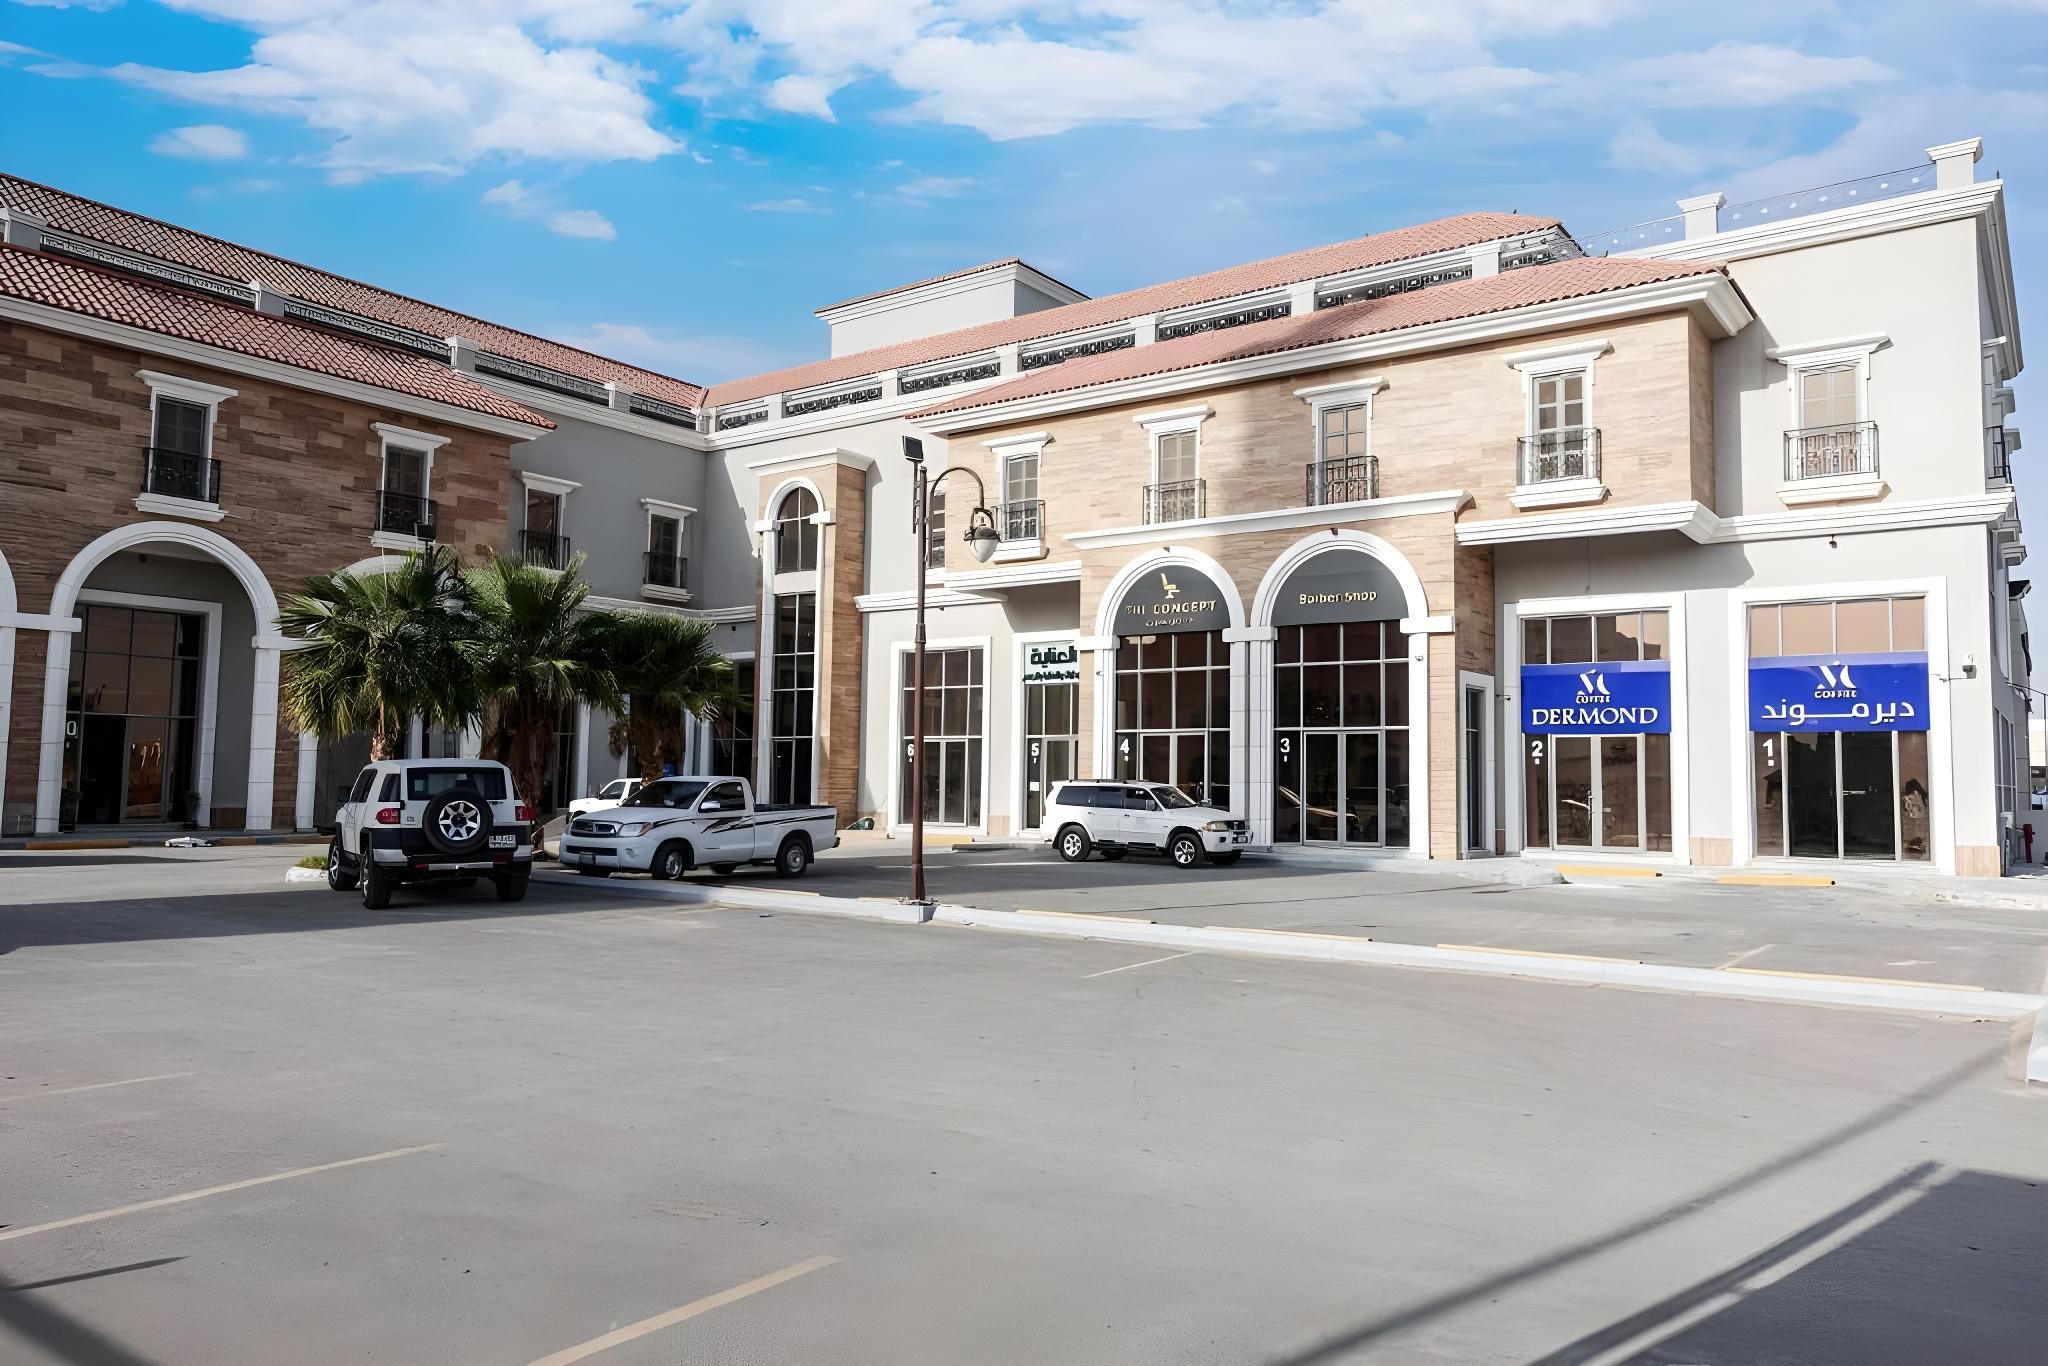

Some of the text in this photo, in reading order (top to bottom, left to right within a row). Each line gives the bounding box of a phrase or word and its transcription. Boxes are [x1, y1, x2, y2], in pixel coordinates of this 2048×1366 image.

[1531, 707, 1658, 725] DERMOND
[1031, 743, 1040, 757] 5
[1119, 738, 1130, 754] 4
[1280, 738, 1290, 753] 3
[1531, 740, 1543, 757] 2
[1762, 738, 1774, 757] 1
